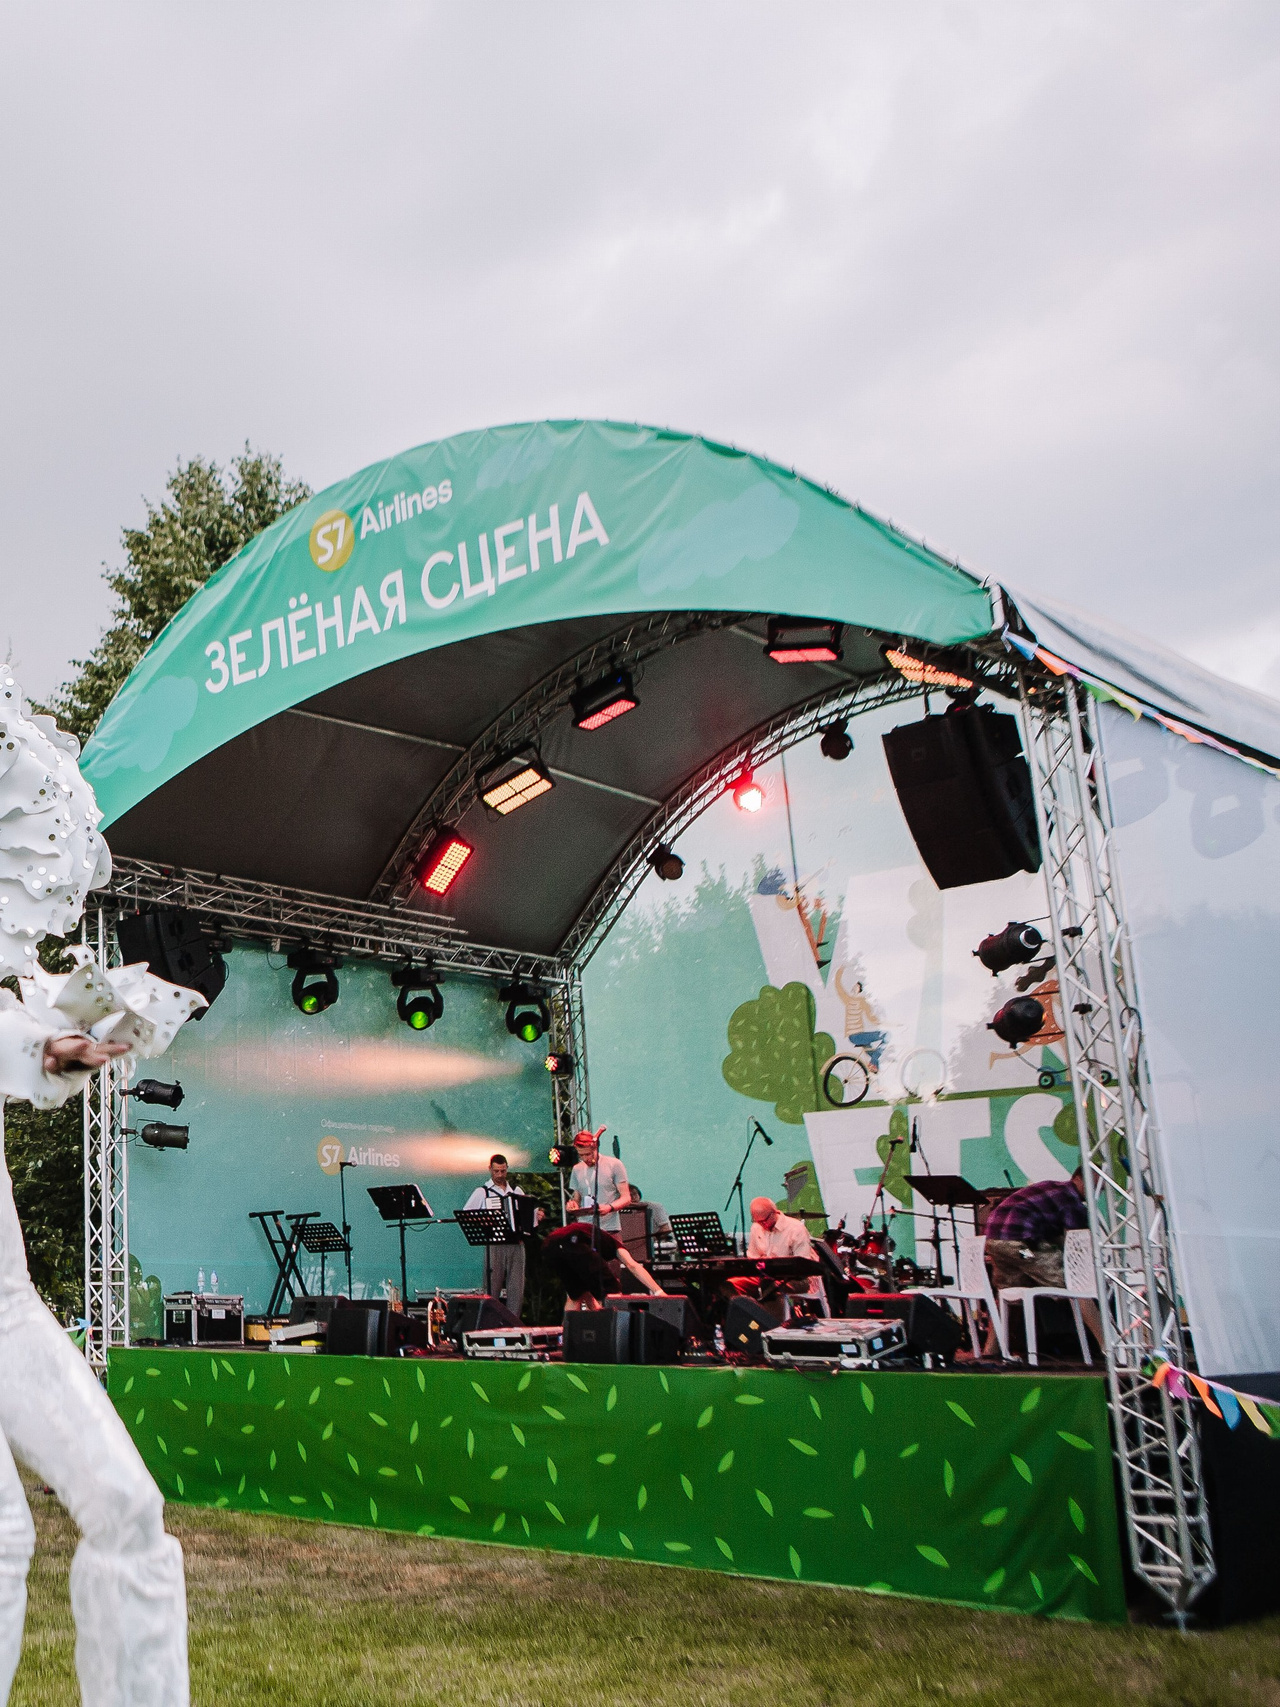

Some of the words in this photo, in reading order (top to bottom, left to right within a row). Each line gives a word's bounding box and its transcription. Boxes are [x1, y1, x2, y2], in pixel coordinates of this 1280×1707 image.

[316, 517, 346, 566] S7
[360, 478, 453, 541] Airlines
[204, 568, 407, 694] ЗЕЛЁНАЯ
[421, 491, 611, 610] СЦЕНА
[320, 1144, 341, 1168] S7
[347, 1146, 401, 1168] Airlines
